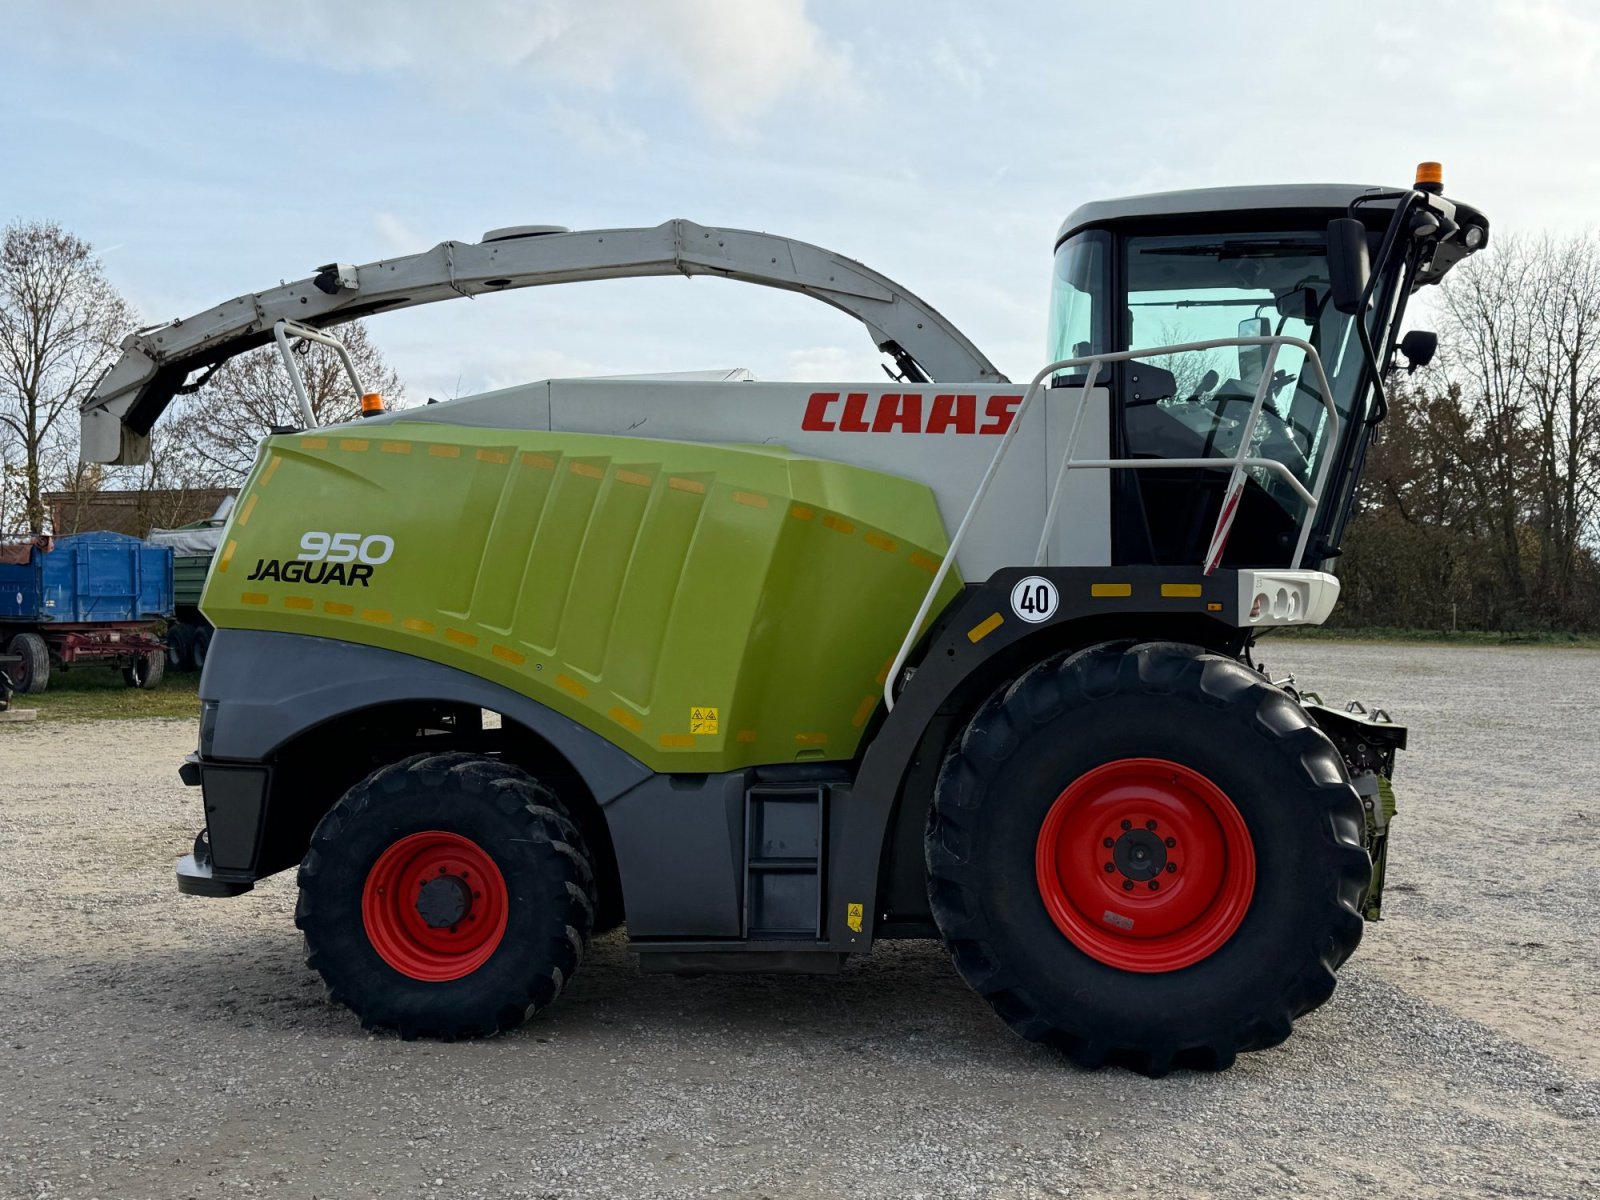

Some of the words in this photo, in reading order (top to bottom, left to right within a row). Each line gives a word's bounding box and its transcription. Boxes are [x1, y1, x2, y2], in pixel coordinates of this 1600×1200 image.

[801, 392, 1024, 435] CLAAS
[297, 531, 395, 565] 950
[247, 559, 374, 587] JAGUAR
[1020, 585, 1049, 614] 40
